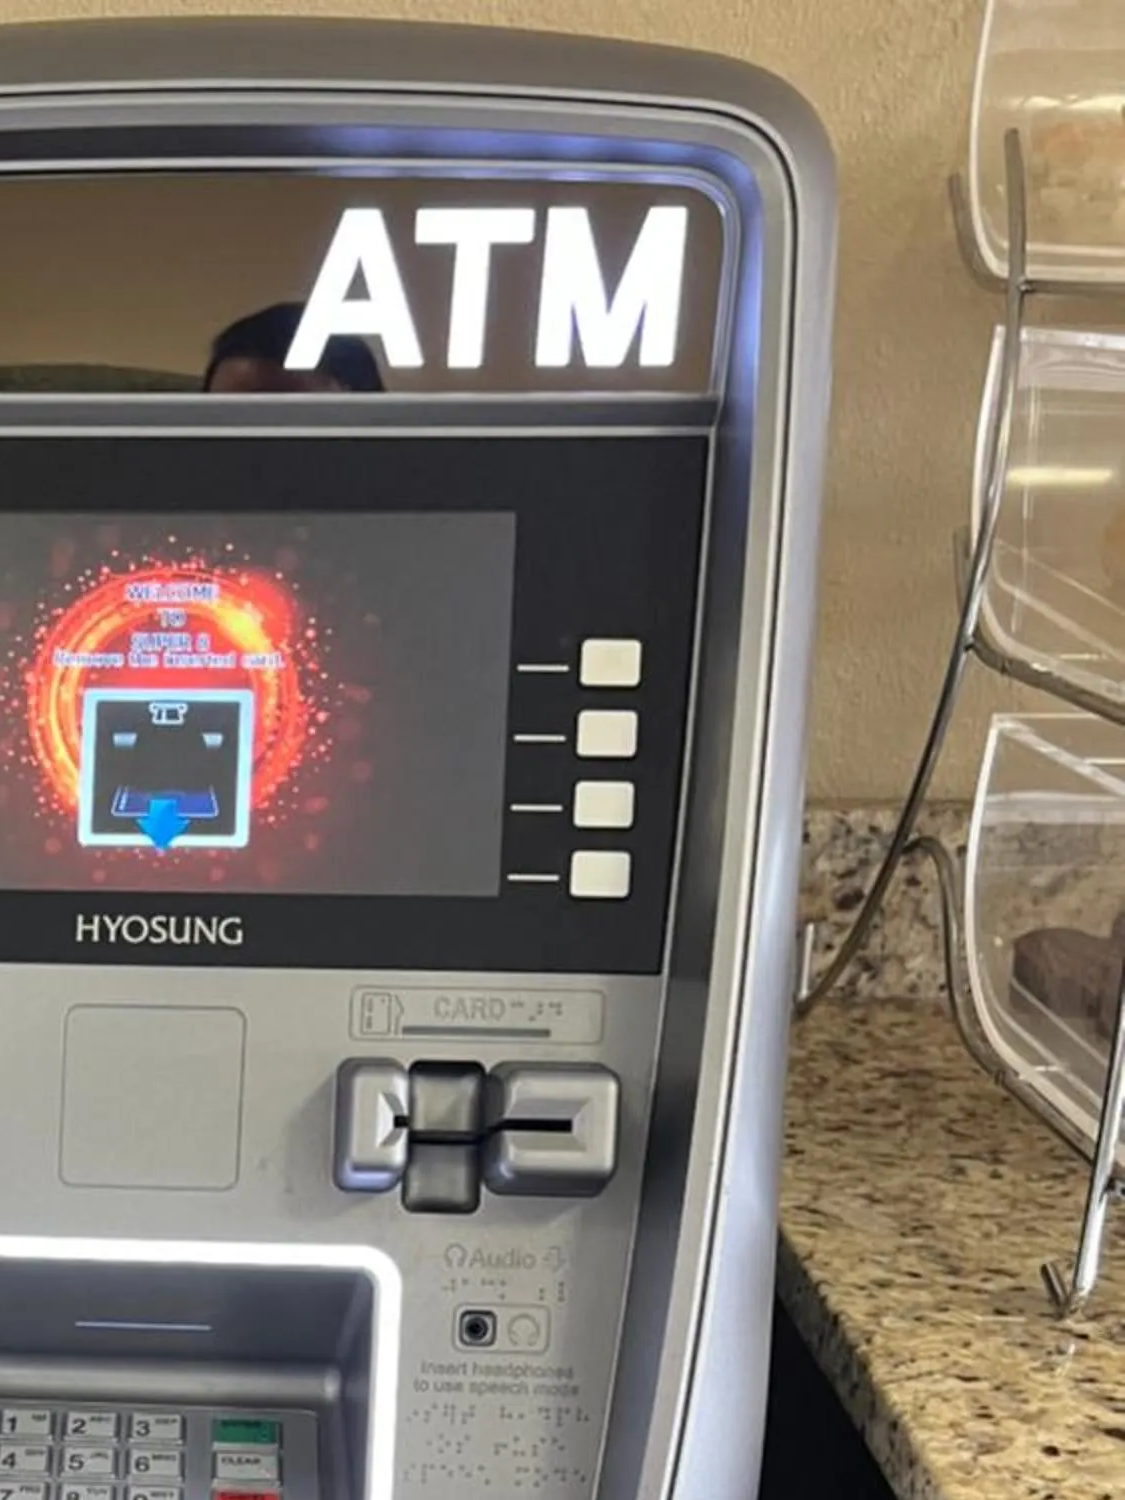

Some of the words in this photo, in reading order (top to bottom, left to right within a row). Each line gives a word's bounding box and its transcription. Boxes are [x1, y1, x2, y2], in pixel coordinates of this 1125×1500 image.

[283, 206, 689, 370] ATM
[75, 914, 243, 945] HYOSUNG
[433, 995, 507, 1020] CARD
[468, 1247, 537, 1270] Audio
[420, 1361, 467, 1376] Insert
[472, 1362, 574, 1380] headphones
[413, 1379, 429, 1393] to
[433, 1382, 463, 1394] use
[469, 1380, 529, 1398] speech
[533, 1381, 579, 1396] mode
[6, 1415, 17, 1432] 1
[71, 1418, 86, 1434] 2
[135, 1420, 150, 1437] 3
[1, 1452, 16, 1469] 4
[68, 1453, 84, 1471] 5
[134, 1455, 150, 1473] 6
[221, 1455, 261, 1466] CLEAR
